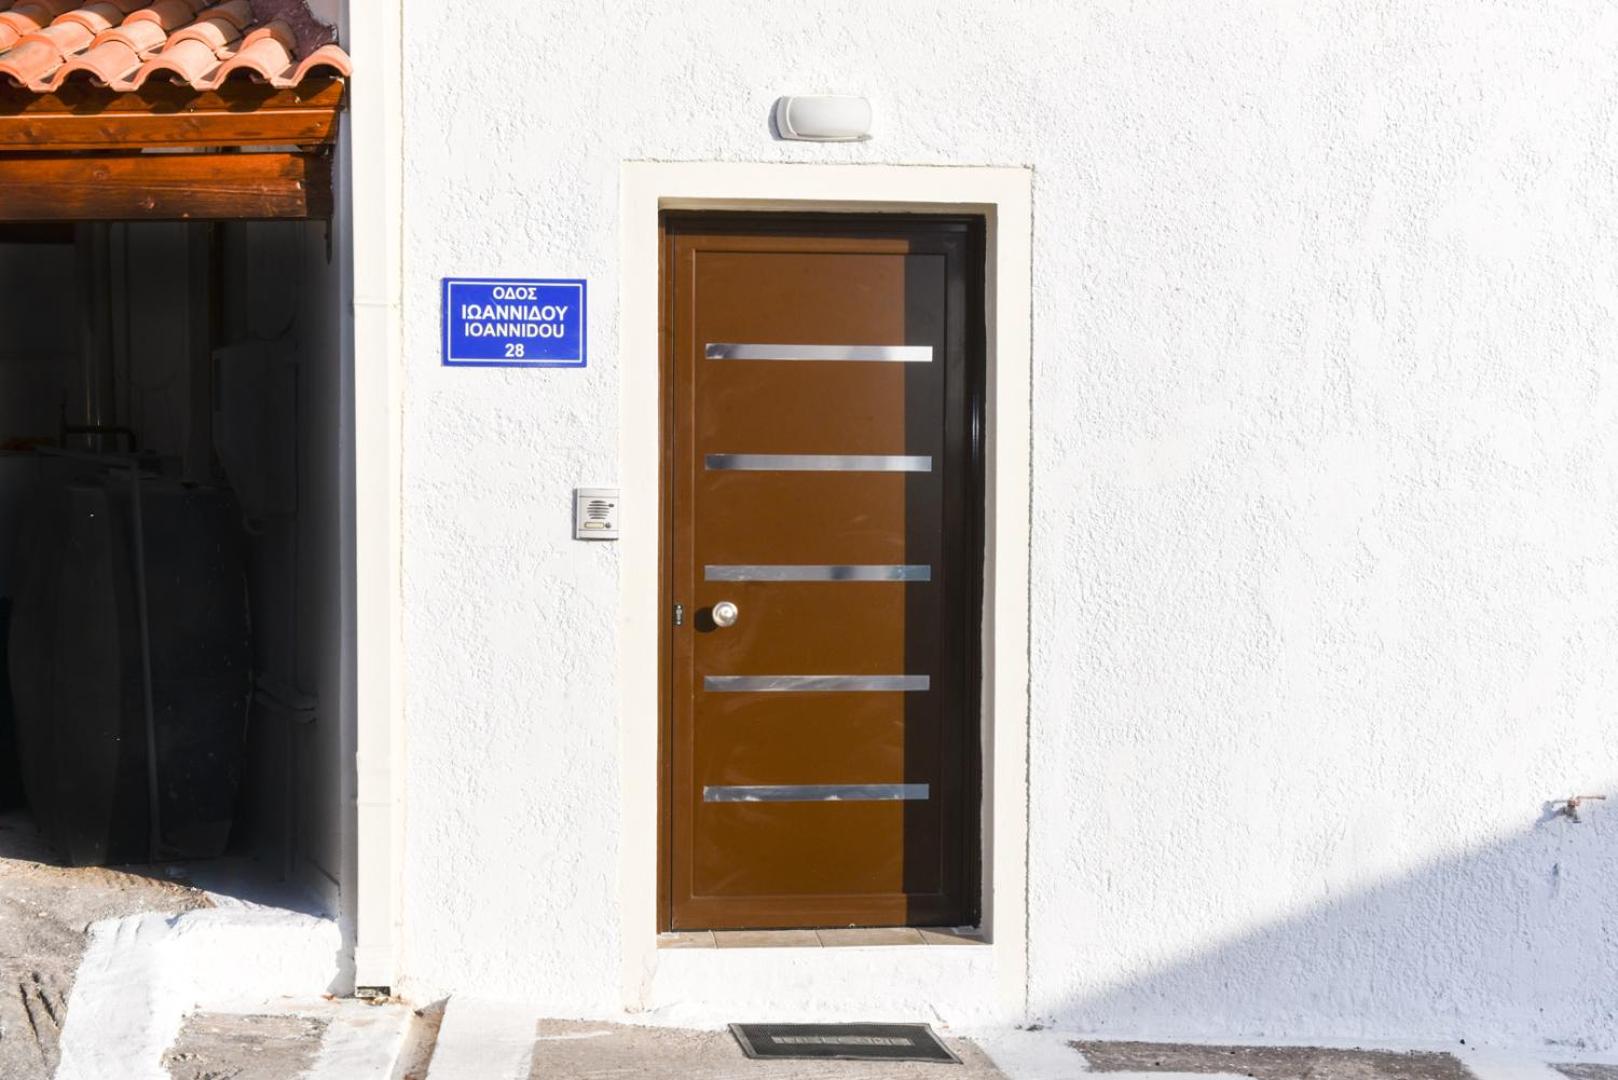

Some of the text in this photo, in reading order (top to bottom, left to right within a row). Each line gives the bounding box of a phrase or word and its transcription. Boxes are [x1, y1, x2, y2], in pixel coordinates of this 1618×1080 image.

[492, 286, 538, 300] ΟΔΟΣ
[461, 304, 568, 321] ΙΩΑΝΝΙΔΟΥ
[464, 322, 565, 338] IOANNIDOU
[504, 343, 525, 358] 28
